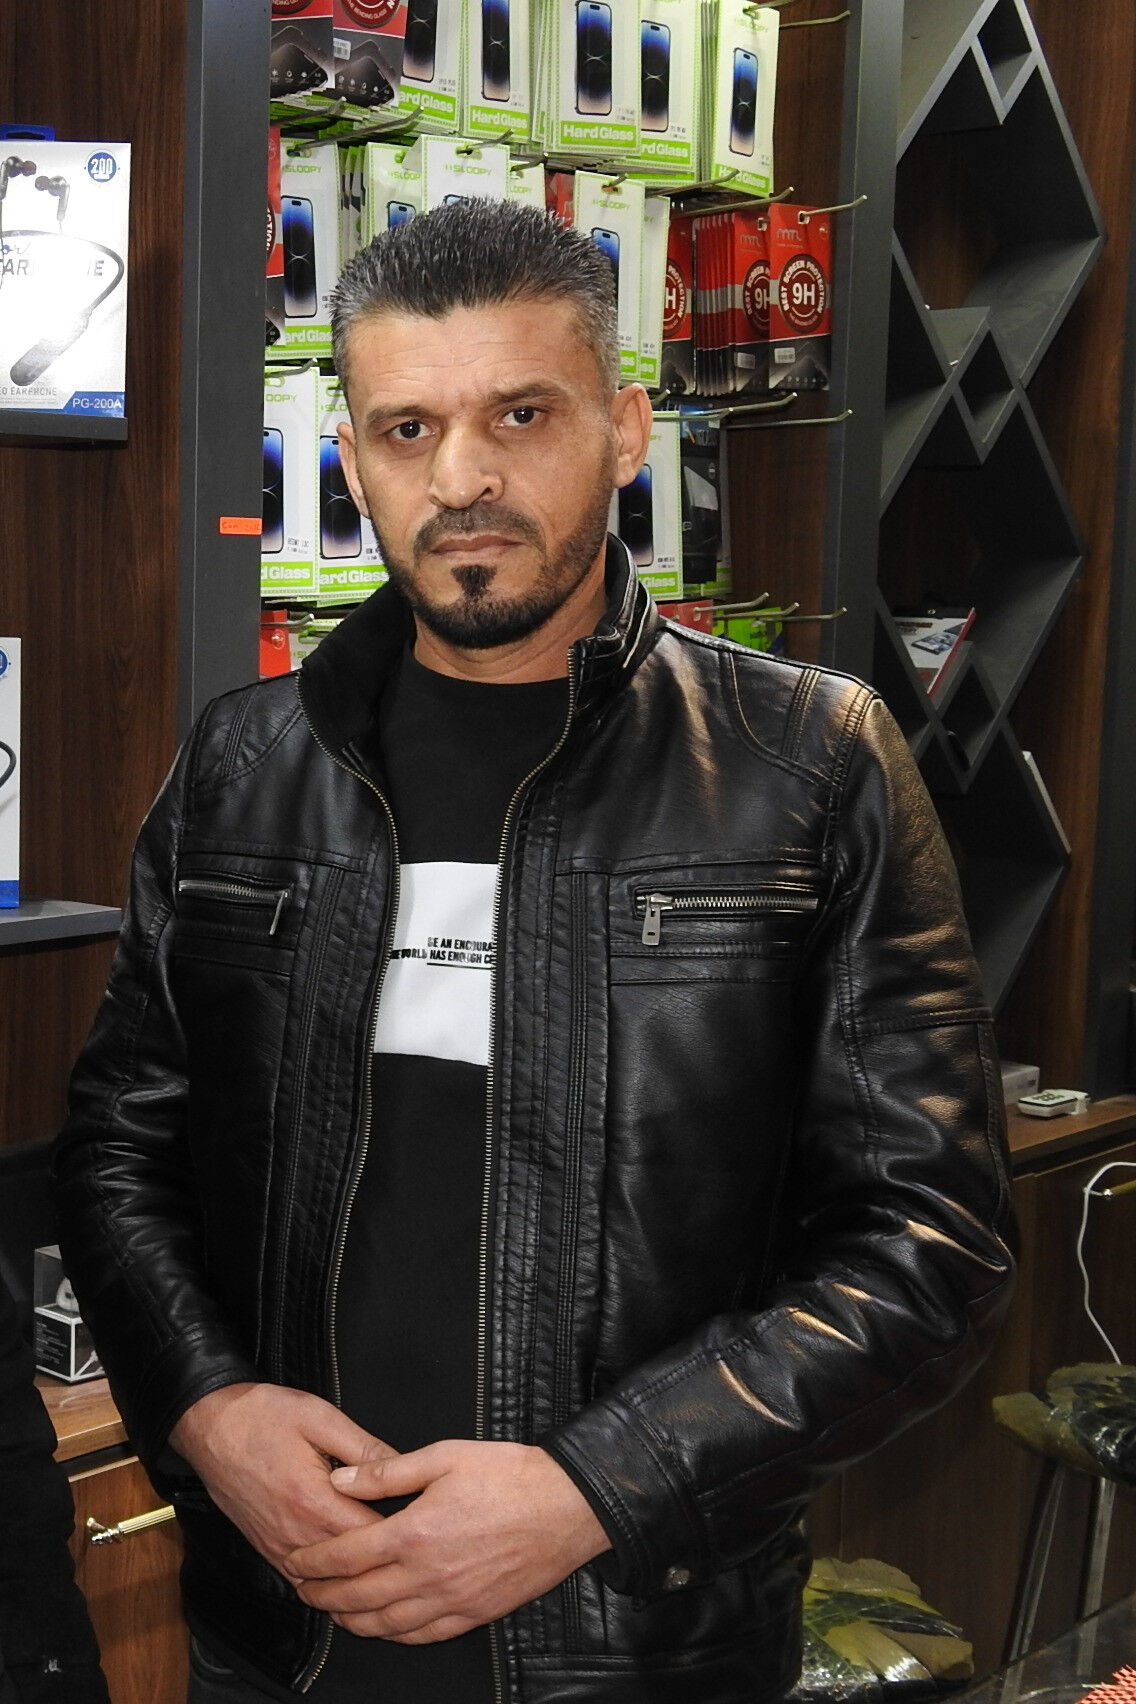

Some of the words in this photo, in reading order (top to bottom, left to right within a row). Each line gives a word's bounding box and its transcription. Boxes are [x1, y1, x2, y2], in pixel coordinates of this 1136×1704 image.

[400, 91, 420, 105] ard
[472, 109, 501, 124] Hard
[501, 113, 528, 129] Glass
[564, 126, 598, 140] Hard
[599, 127, 634, 142] Glass
[90, 158, 113, 174] 200
[783, 260, 805, 284] SCREEN
[792, 283, 815, 305] 9H
[806, 261, 827, 314] PROTECTION
[781, 286, 790, 311] BEST
[285, 330, 306, 343] ard
[306, 330, 332, 343] Glas
[11, 387, 57, 396] EARPHONE
[72, 398, 122, 408] PG-200A
[269, 566, 310, 581] Glass
[320, 571, 347, 585] ard
[349, 569, 390, 583] Glass
[441, 938, 452, 948] AN
[401, 949, 427, 959] WORLD
[430, 950, 447, 960] HAS
[448, 951, 482, 963] ENOUGH
